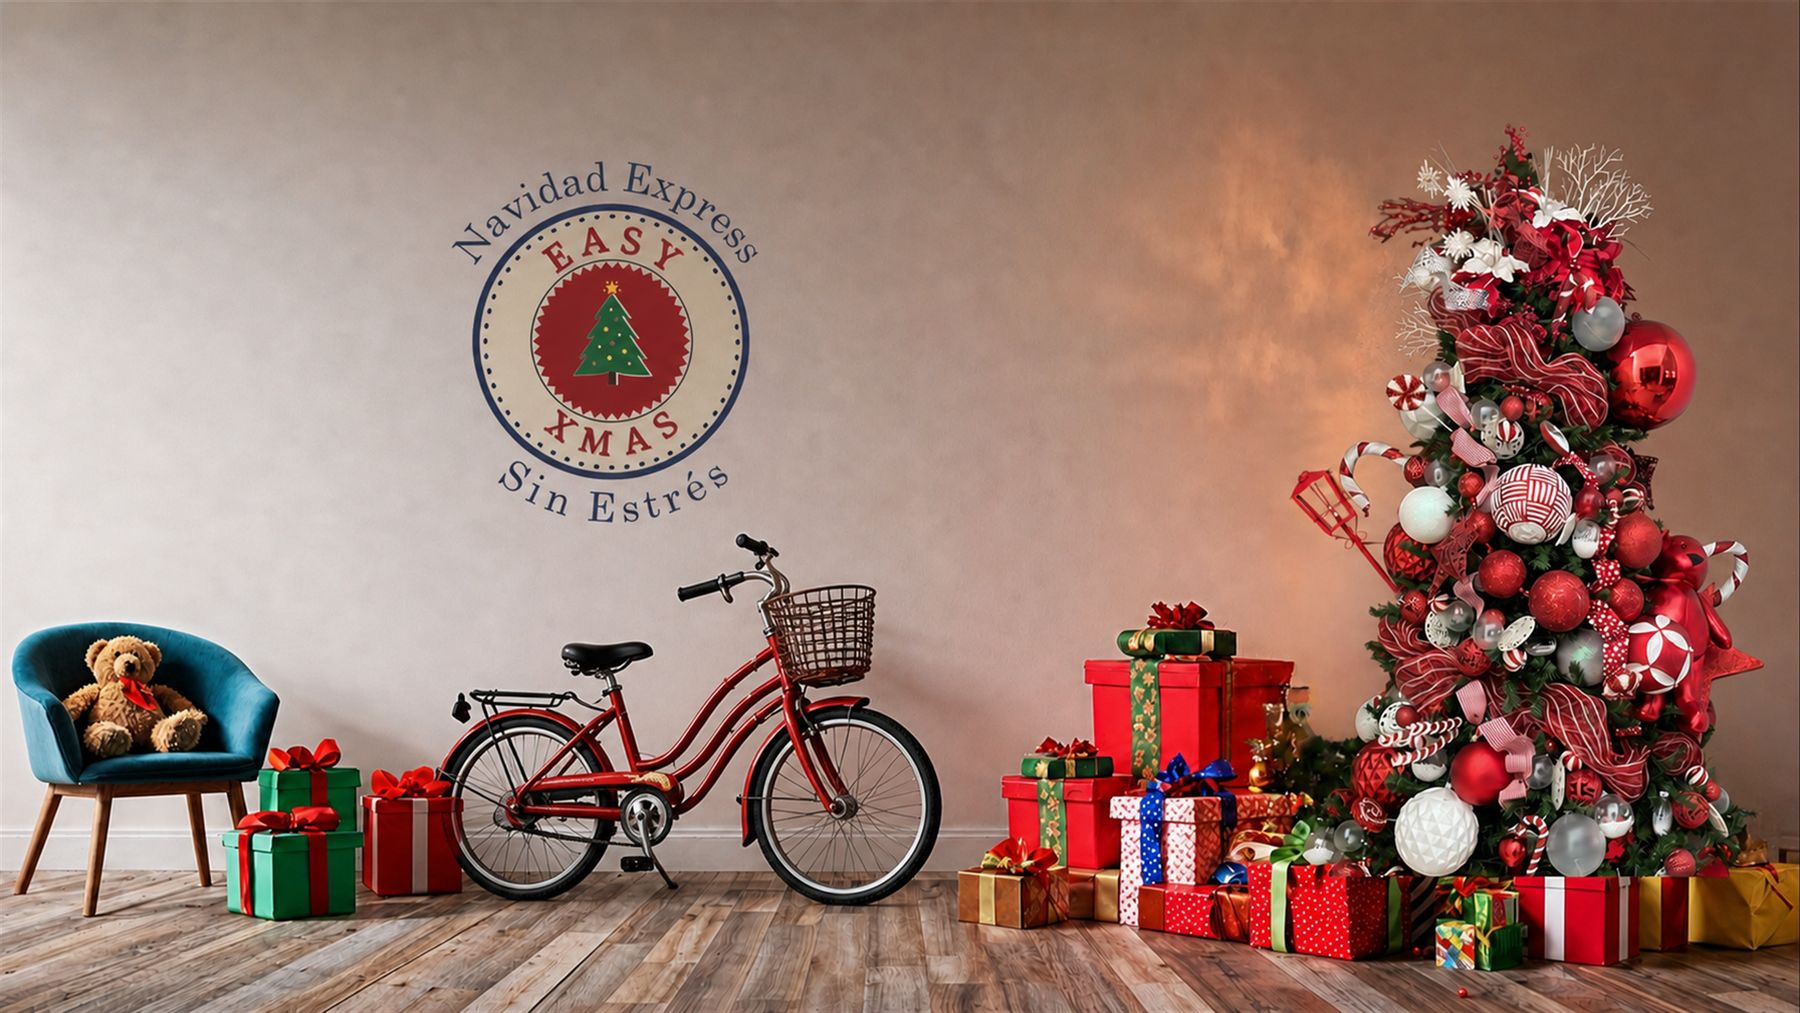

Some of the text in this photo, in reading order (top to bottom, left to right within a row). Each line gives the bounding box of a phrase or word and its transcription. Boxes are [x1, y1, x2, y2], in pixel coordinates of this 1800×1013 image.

[452, 161, 758, 265] Navidad Express
[542, 226, 684, 273] EASY
[543, 409, 678, 457] XMAS
[498, 460, 729, 523] Sin Estrés
